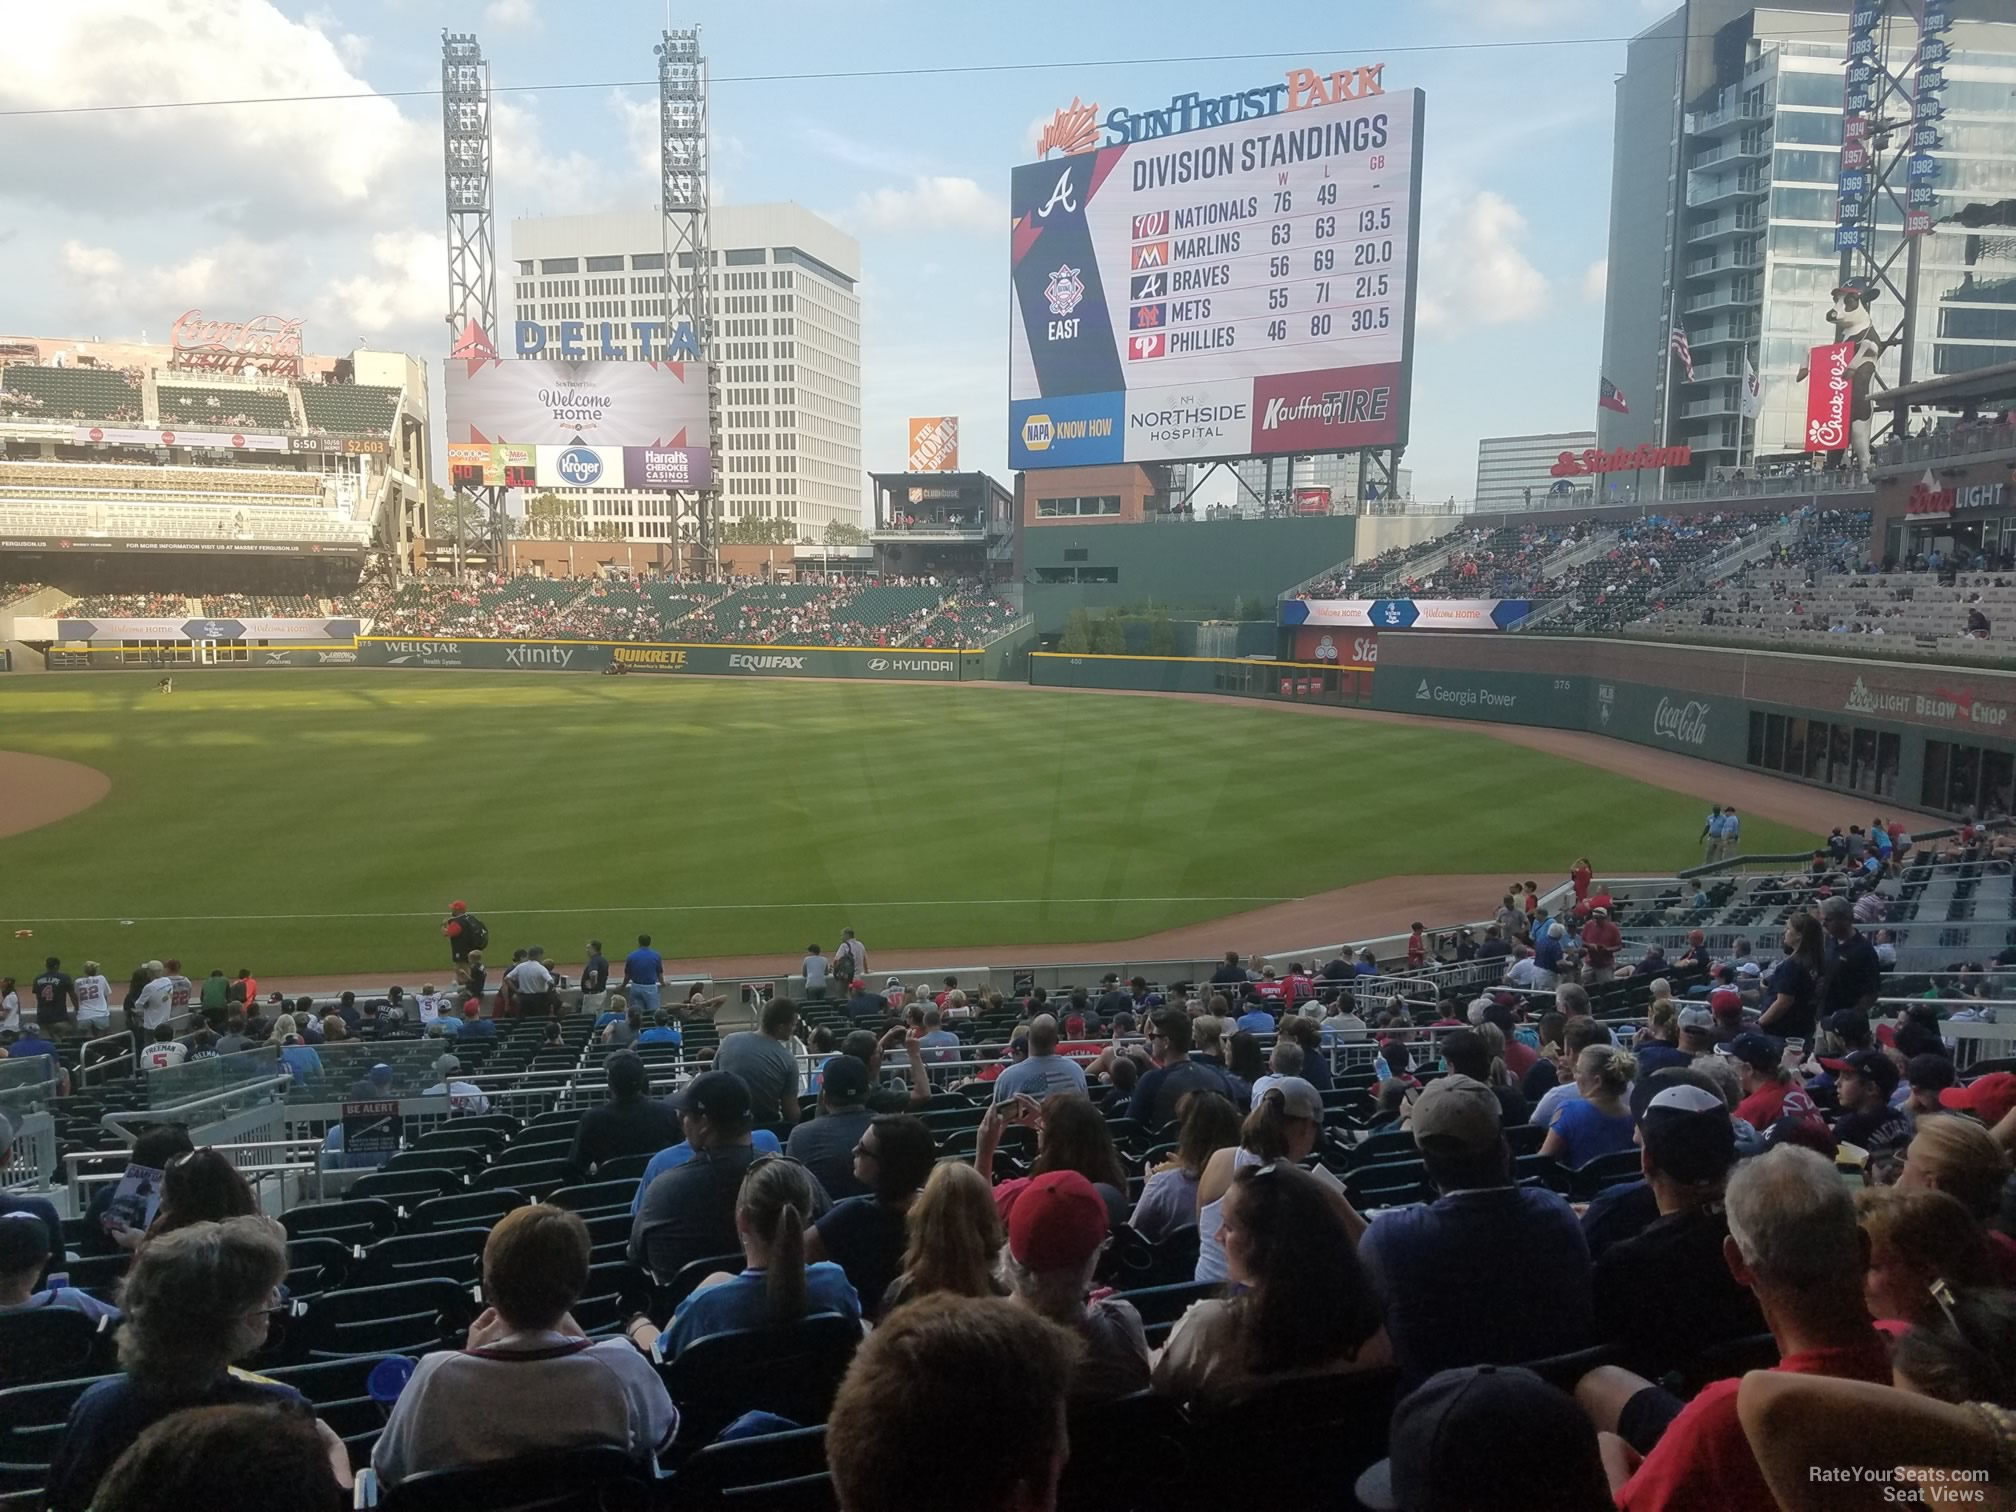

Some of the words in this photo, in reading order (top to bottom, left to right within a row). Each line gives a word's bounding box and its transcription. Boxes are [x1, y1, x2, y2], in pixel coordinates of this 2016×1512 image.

[1853, 11, 1873, 28] 1877
[1851, 39, 1871, 55] 1883
[1921, 44, 1943, 60] 1893
[1849, 67, 1870, 83] 1892
[1918, 73, 1941, 89] 1898
[1847, 95, 1867, 110] 1897
[1916, 102, 1938, 117] 1948
[1846, 122, 1864, 137] 1914
[1914, 131, 1936, 146] 1958
[1133, 142, 1234, 192] DIVISION
[1241, 113, 1388, 172] STANDINGS
[1844, 150, 1863, 164] 1957
[1278, 172, 1289, 186] W
[1324, 165, 1331, 178] L
[1369, 155, 1385, 170] GB
[1911, 160, 1933, 175] 1982
[1842, 177, 1862, 191] 1969
[1909, 188, 1931, 203] 1992
[1174, 197, 1258, 230] NATIONALS
[1273, 191, 1292, 213] 76
[1316, 183, 1337, 206] 49
[1840, 204, 1859, 218] 1991
[1908, 216, 1929, 231] 1995
[1173, 231, 1241, 261] MARLINS
[1271, 223, 1291, 245] 63
[1315, 216, 1335, 239] 63
[1358, 207, 1391, 233] 13.5
[1839, 231, 1858, 245] 1993
[1172, 264, 1230, 292] BRAVES
[1270, 255, 1290, 278] 56
[1313, 249, 1334, 272] 69
[1354, 240, 1392, 266] 20.0
[1171, 298, 1212, 323] METS
[1268, 288, 1288, 310] 55
[1315, 281, 1330, 304] 71
[1355, 274, 1388, 299] 21.5
[1048, 318, 1080, 341] EAST
[1170, 326, 1235, 353] PHILLIES
[1267, 319, 1287, 341] 46
[1310, 314, 1331, 336] 80
[1351, 307, 1390, 332] 30.5
[516, 321, 700, 356] DELTA
[538, 388, 612, 408] Welcome
[1817, 346, 1848, 446] Chick-fil-A
[1130, 404, 1247, 429] NORTHSIDE
[1262, 397, 1343, 431] Kauffman
[1322, 387, 1390, 425] TIRE
[914, 423, 934, 445] THE
[1027, 427, 1049, 441] NAPA
[1057, 421, 1086, 440] KNOW
[1089, 418, 1112, 437] HOW
[1150, 429, 1224, 442] HOSPITAL
[293, 439, 317, 449] 6:50
[348, 440, 384, 453] $2,603
[910, 417, 957, 470] HOME
[645, 450, 688, 464] Harrah's
[927, 436, 957, 470] DEPOT
[562, 453, 600, 481] Kroger
[646, 464, 688, 472] CHEROKEE
[646, 472, 689, 480] CASINOS
[923, 488, 959, 497] CLUBHOUSE
[1955, 483, 2004, 509] LIGHT
[1423, 608, 1454, 619] Welcome
[385, 642, 459, 655] WELLSTAR
[505, 644, 574, 667] xfinity
[614, 648, 687, 663] QUIKRETE
[729, 654, 804, 671] EQUIFAX
[893, 660, 954, 672] HYUNDAI
[1554, 680, 1571, 690] 375
[1434, 686, 1476, 706] Georgia
[1479, 690, 1517, 707] Power
[1879, 695, 1910, 713] LIGHT
[1916, 696, 1957, 720] BELOW
[1971, 702, 2007, 725] CHOP
[42, 985, 54, 1001] 4
[80, 985, 99, 1000] 22
[424, 1001, 432, 1011] 5
[146, 1045, 177, 1056] FREEMAN
[153, 1053, 168, 1068] 5
[347, 1105, 361, 1114] BE
[363, 1103, 394, 1113] ALERT
